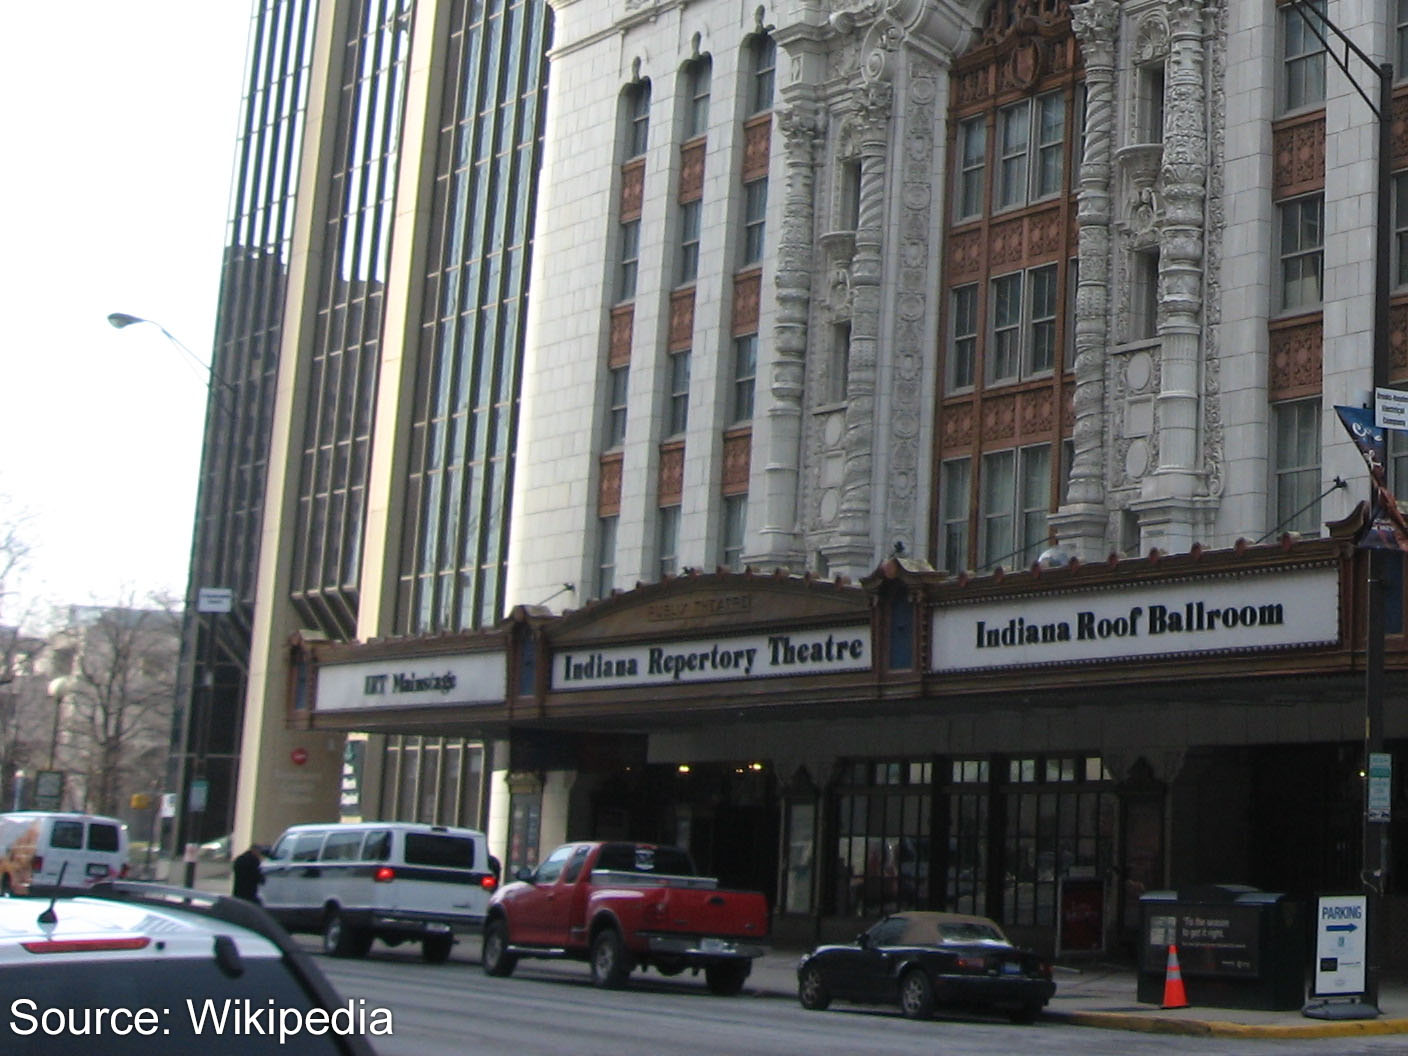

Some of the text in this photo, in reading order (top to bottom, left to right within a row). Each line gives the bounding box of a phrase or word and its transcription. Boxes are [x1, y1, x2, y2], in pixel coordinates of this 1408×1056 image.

[976, 601, 1284, 649] Indiana Roof Ballroom
[564, 634, 864, 682] Indiana Repertory Theatre
[1322, 906, 1362, 920] PARKING
